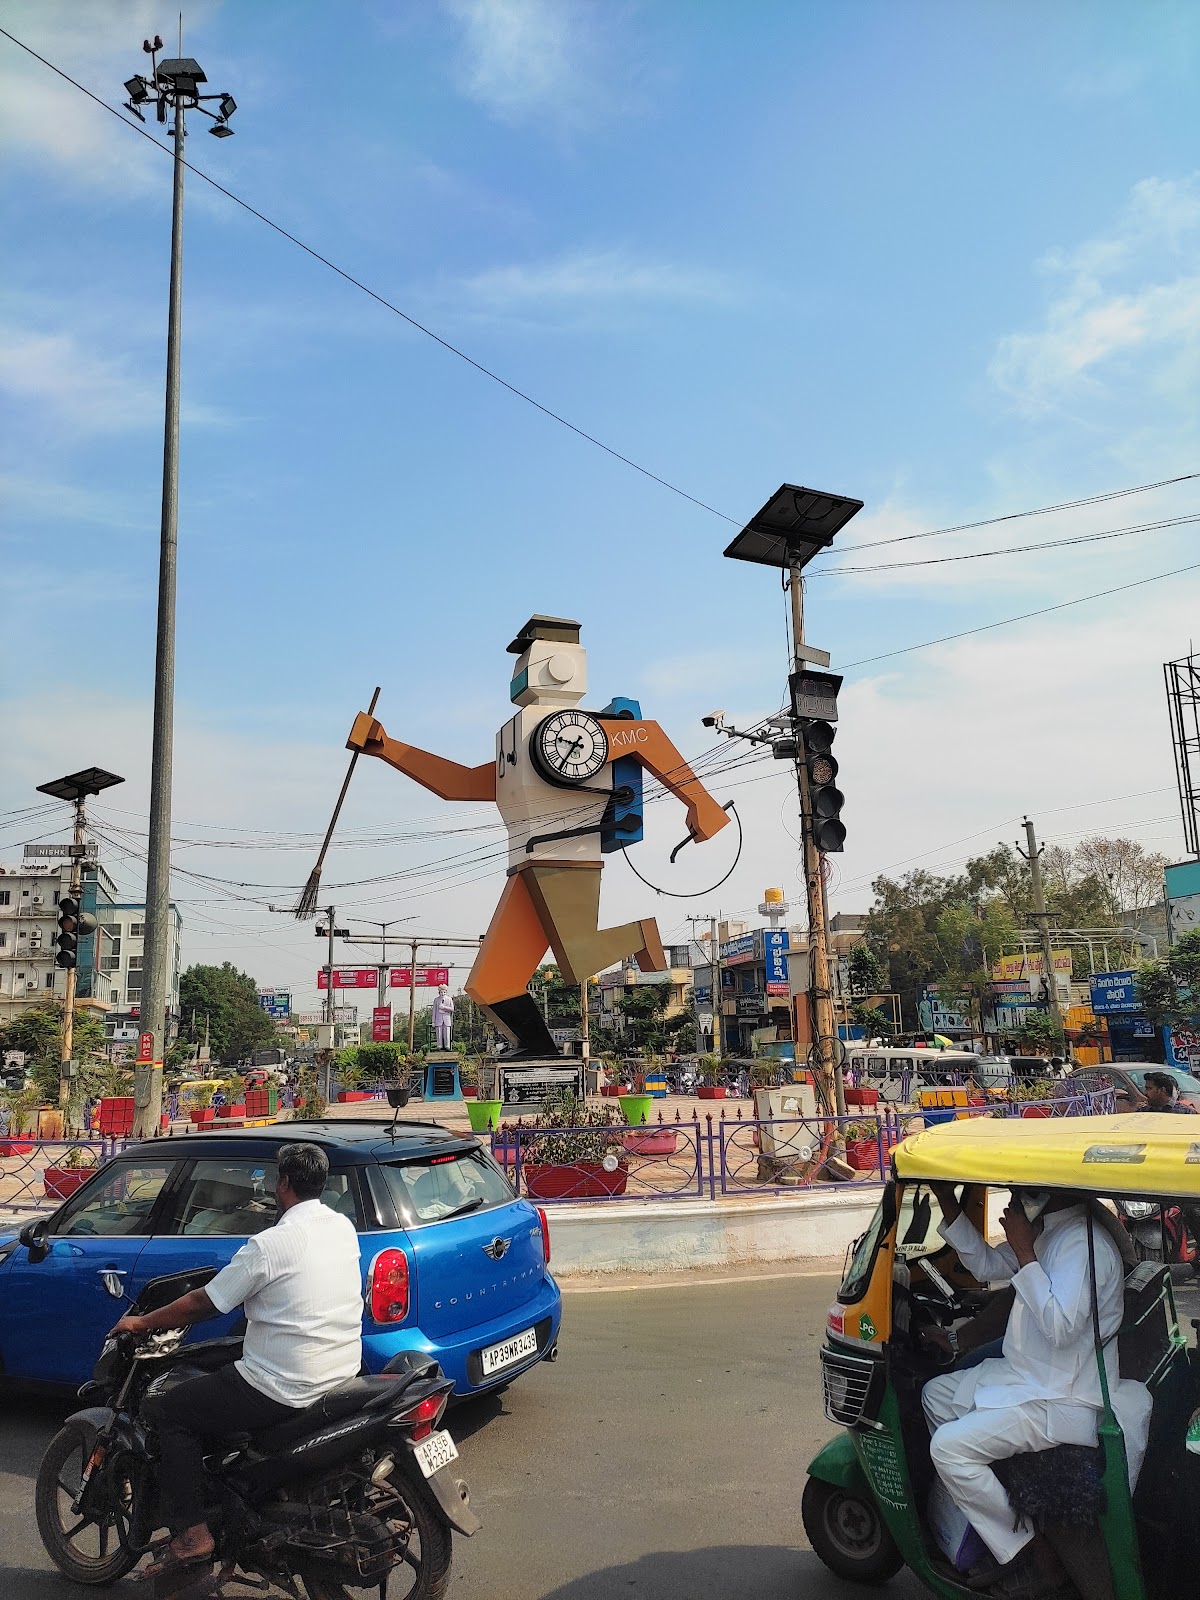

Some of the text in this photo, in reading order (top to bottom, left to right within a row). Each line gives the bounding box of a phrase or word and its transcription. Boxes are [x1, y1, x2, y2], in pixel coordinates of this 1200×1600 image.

[611, 727, 649, 747] KMC
[143, 1035, 151, 1056] KMC
[434, 1264, 542, 1309] COUNTRYMAN
[859, 1320, 875, 1335] LPG
